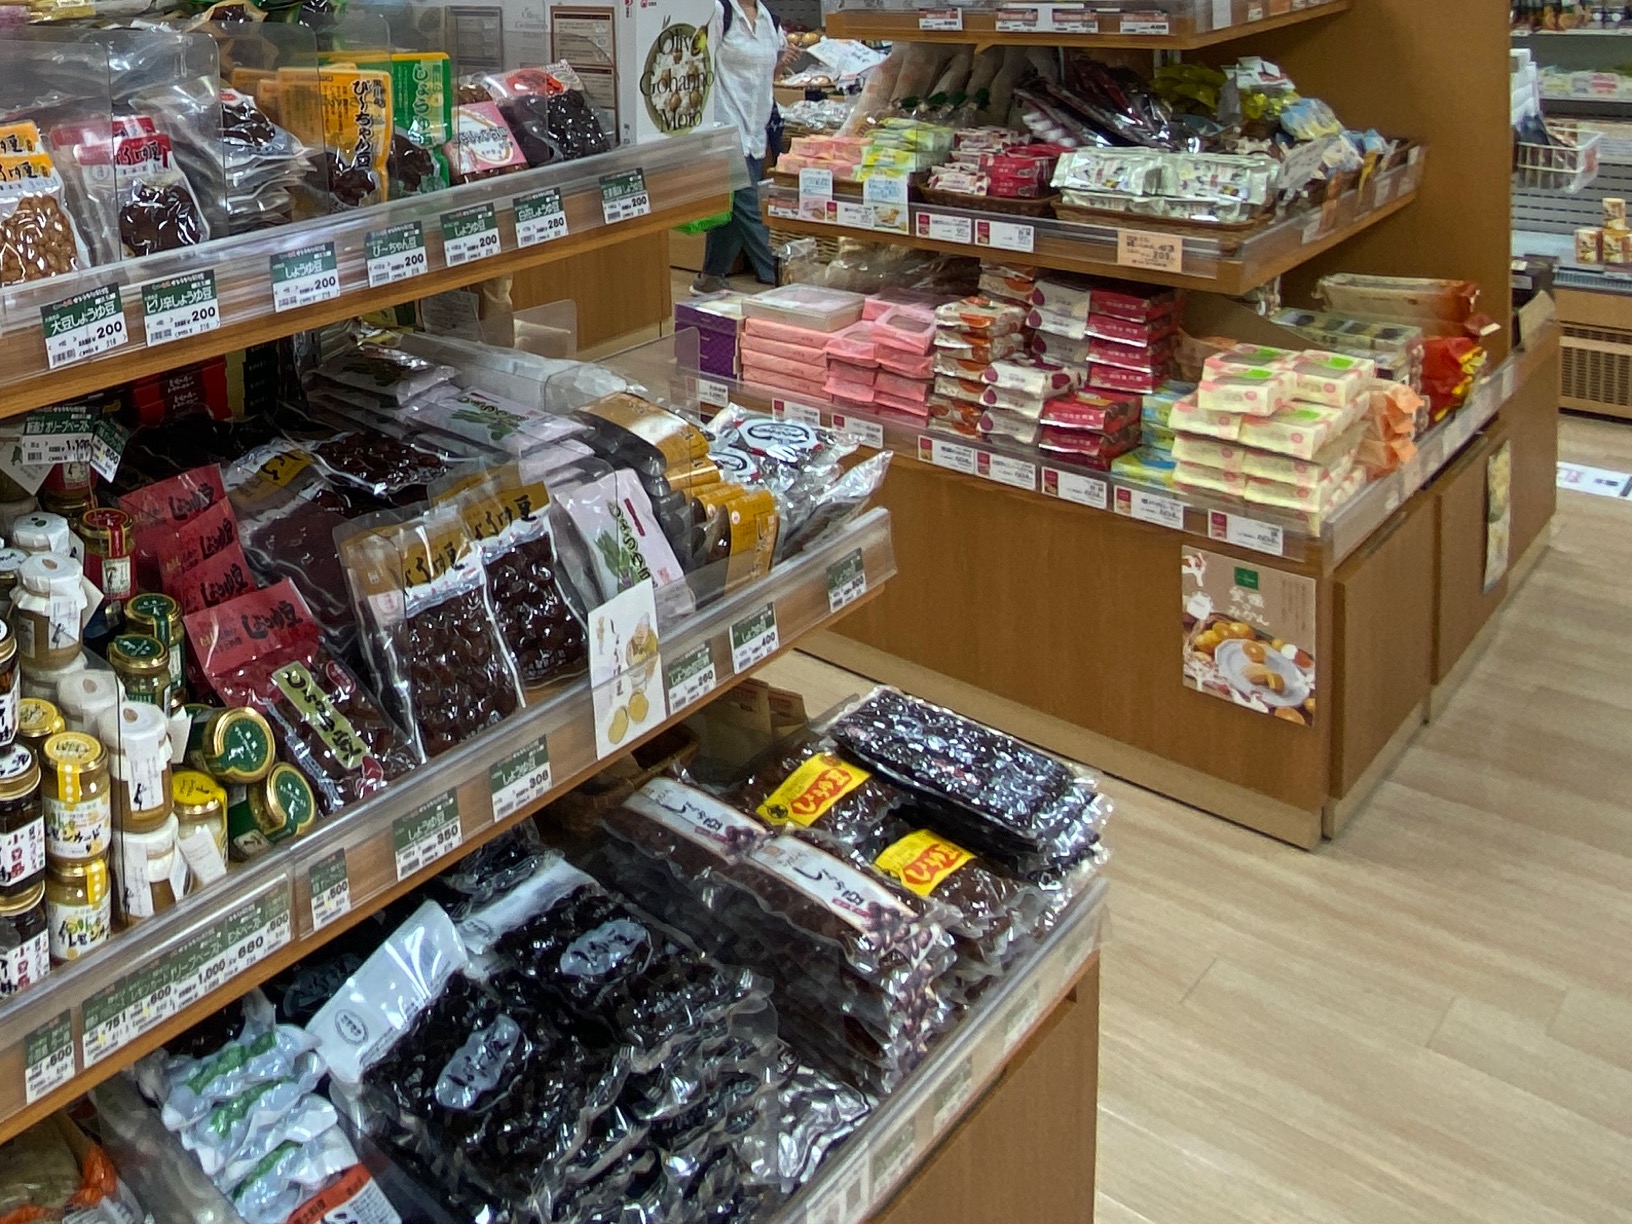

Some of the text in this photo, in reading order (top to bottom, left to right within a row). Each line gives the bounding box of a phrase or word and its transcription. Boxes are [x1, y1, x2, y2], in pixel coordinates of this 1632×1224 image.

[658, 29, 707, 57] Olive
[631, 195, 647, 207] 200
[548, 216, 565, 229] 280
[479, 234, 497, 247] 200
[405, 252, 425, 266] 200
[285, 260, 324, 278] しょうゆ豆
[314, 276, 336, 290] 200
[146, 289, 213, 314] ピリ辛しょうゆ豆
[51, 303, 117, 336] 大豆しょうゆ豆
[192, 307, 216, 323] 200
[97, 322, 123, 339] 200
[241, 601, 304, 639] しょうゆ豆
[197, 960, 227, 984] 1,000
